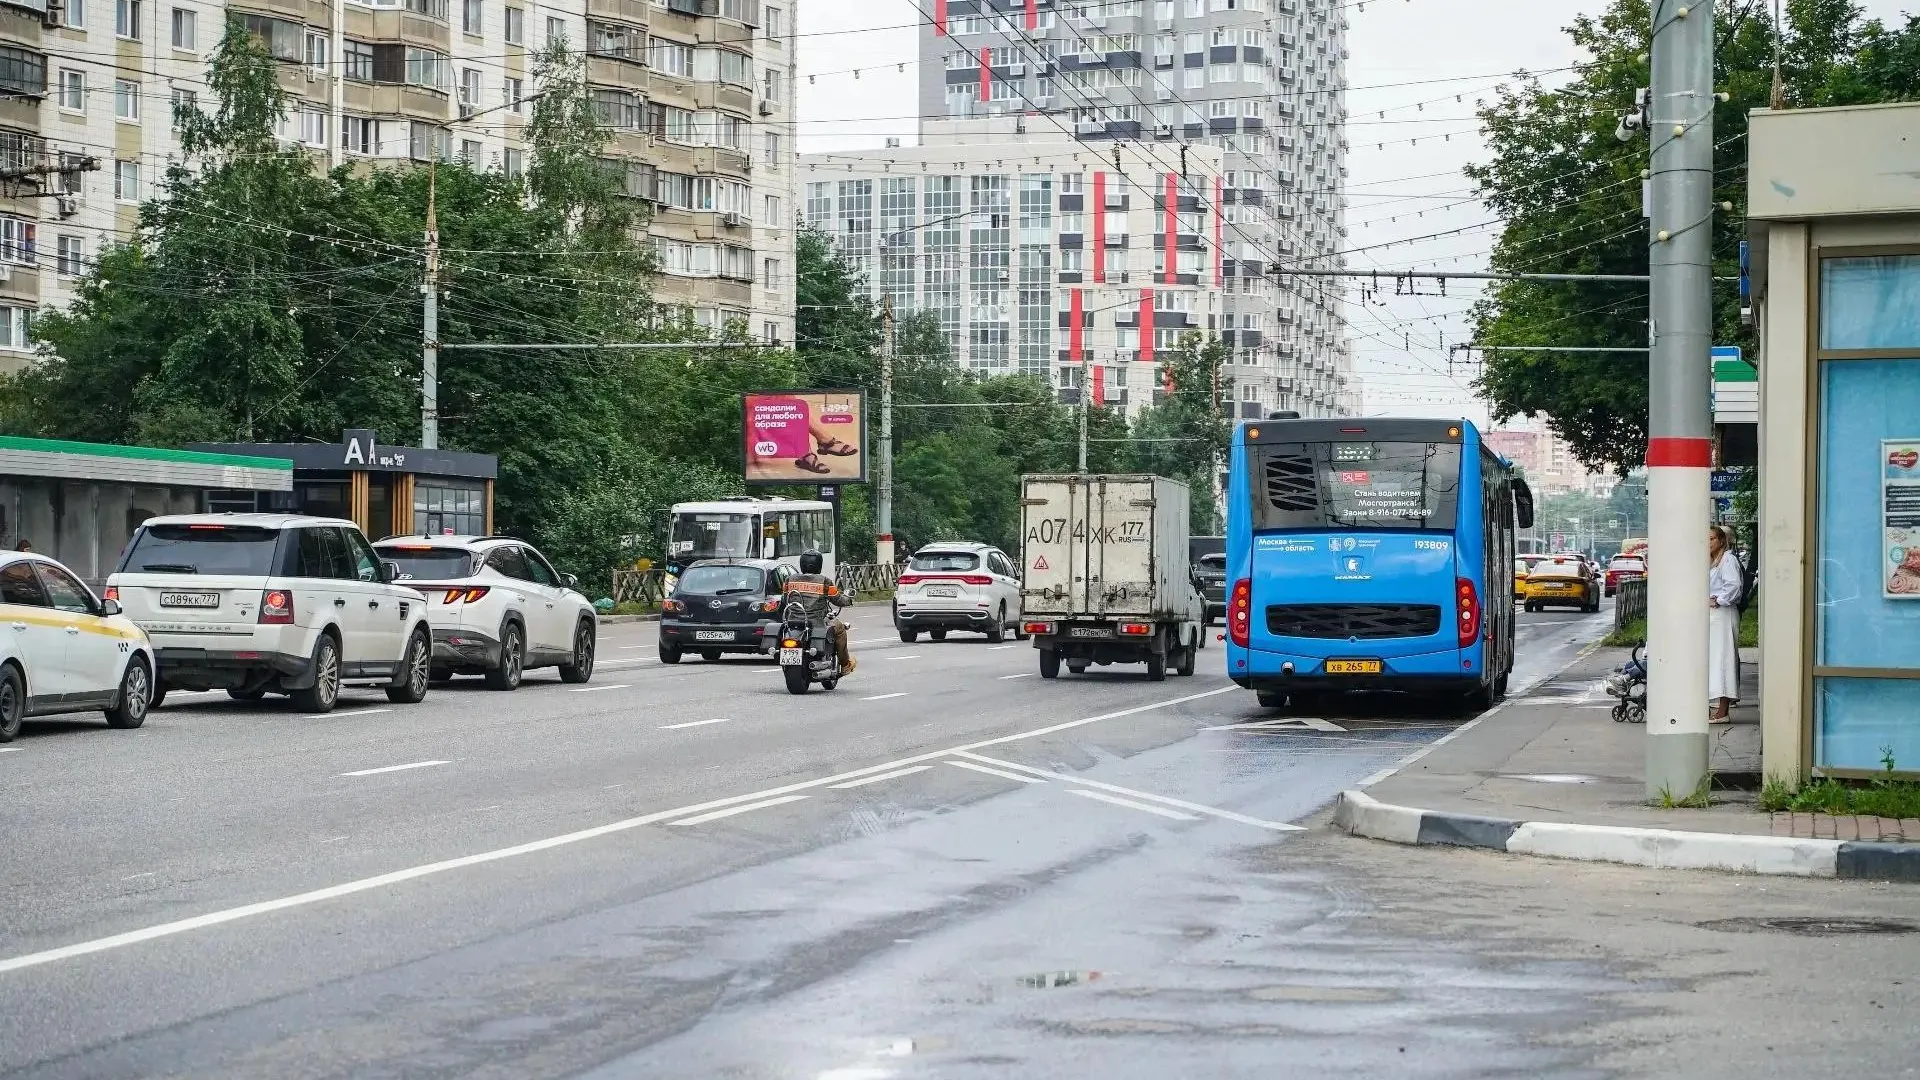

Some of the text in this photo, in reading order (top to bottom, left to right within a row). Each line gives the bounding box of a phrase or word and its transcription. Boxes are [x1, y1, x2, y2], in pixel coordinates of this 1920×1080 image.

[755, 404, 796, 413] сандалии
[772, 411, 804, 420] любого
[755, 421, 787, 429] образа
[758, 441, 775, 453] wb
[1354, 489, 1421, 498] Стань водителем
[1358, 499, 1417, 507] Мосгортранса!
[1120, 521, 1144, 535] 177
[1414, 540, 1449, 550] 193809
[1346, 662, 1363, 671] 265
